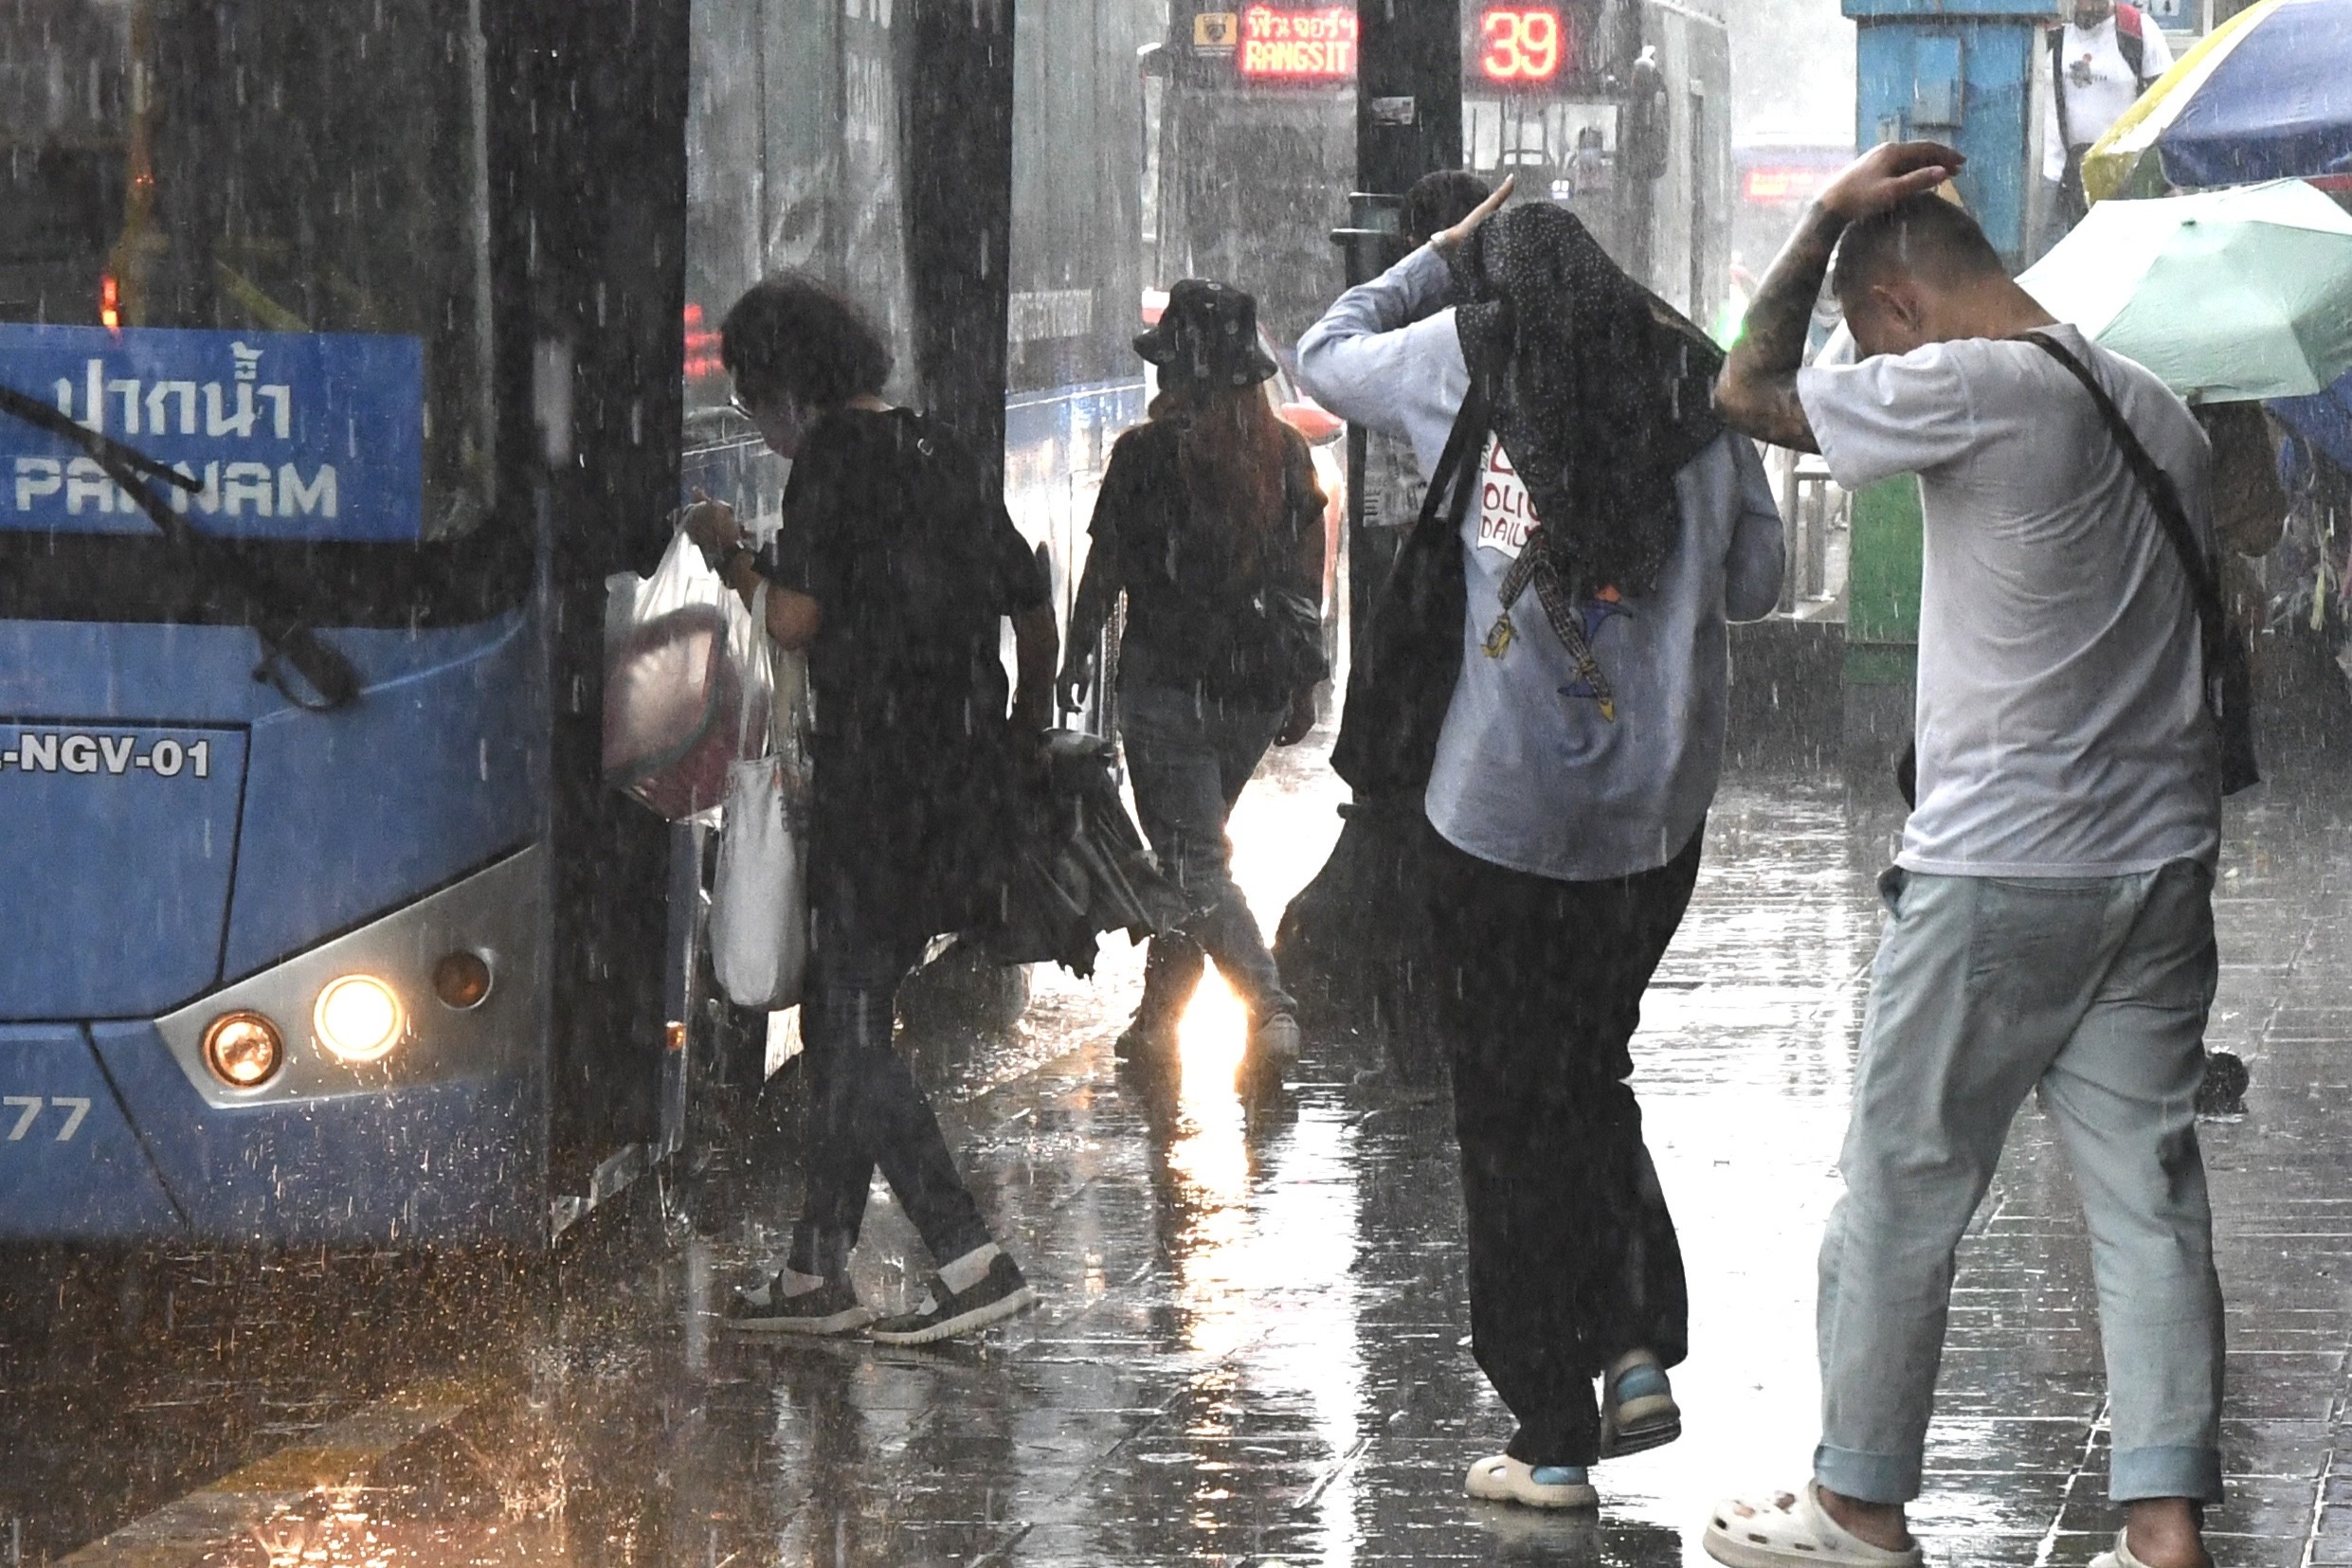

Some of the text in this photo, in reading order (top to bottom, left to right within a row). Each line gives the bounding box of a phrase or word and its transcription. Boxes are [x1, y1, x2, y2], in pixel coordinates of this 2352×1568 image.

[1244, 40, 1351, 72] RANGSIT
[1485, 11, 1557, 76] 39
[54, 340, 291, 440] ปากน้ำ
[0, 732, 208, 778] -NGV-01
[3, 1096, 91, 1141] 77
